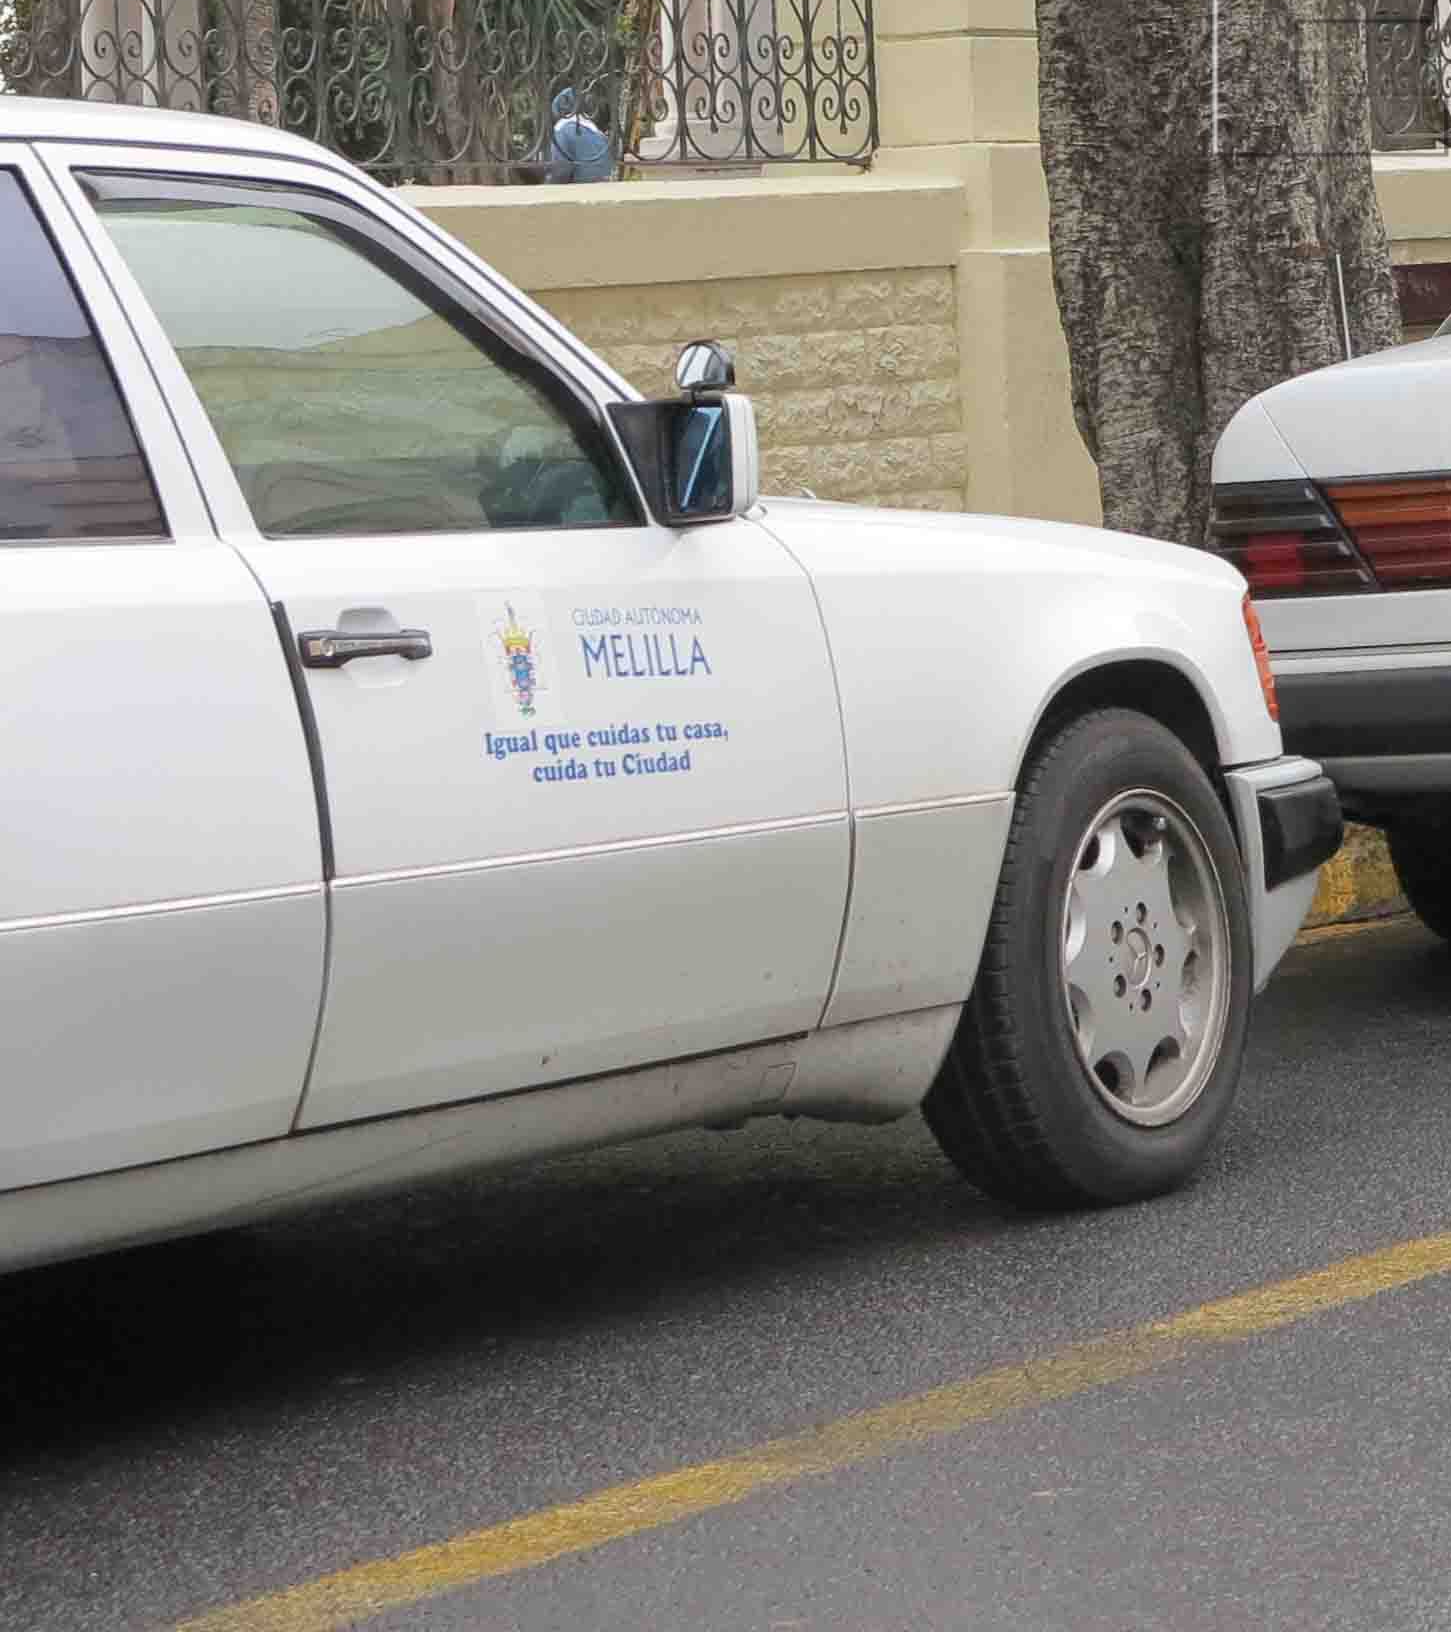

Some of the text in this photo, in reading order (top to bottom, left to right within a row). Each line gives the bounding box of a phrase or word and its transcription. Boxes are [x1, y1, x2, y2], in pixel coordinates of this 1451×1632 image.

[571, 608, 621, 627] CIUDAD
[579, 634, 712, 678] MELILLA
[484, 729, 538, 760] Igual
[544, 732, 582, 755] que
[587, 723, 651, 747] cuidas
[656, 722, 677, 742] tu
[532, 750, 691, 783] cuida tu Ciudad
